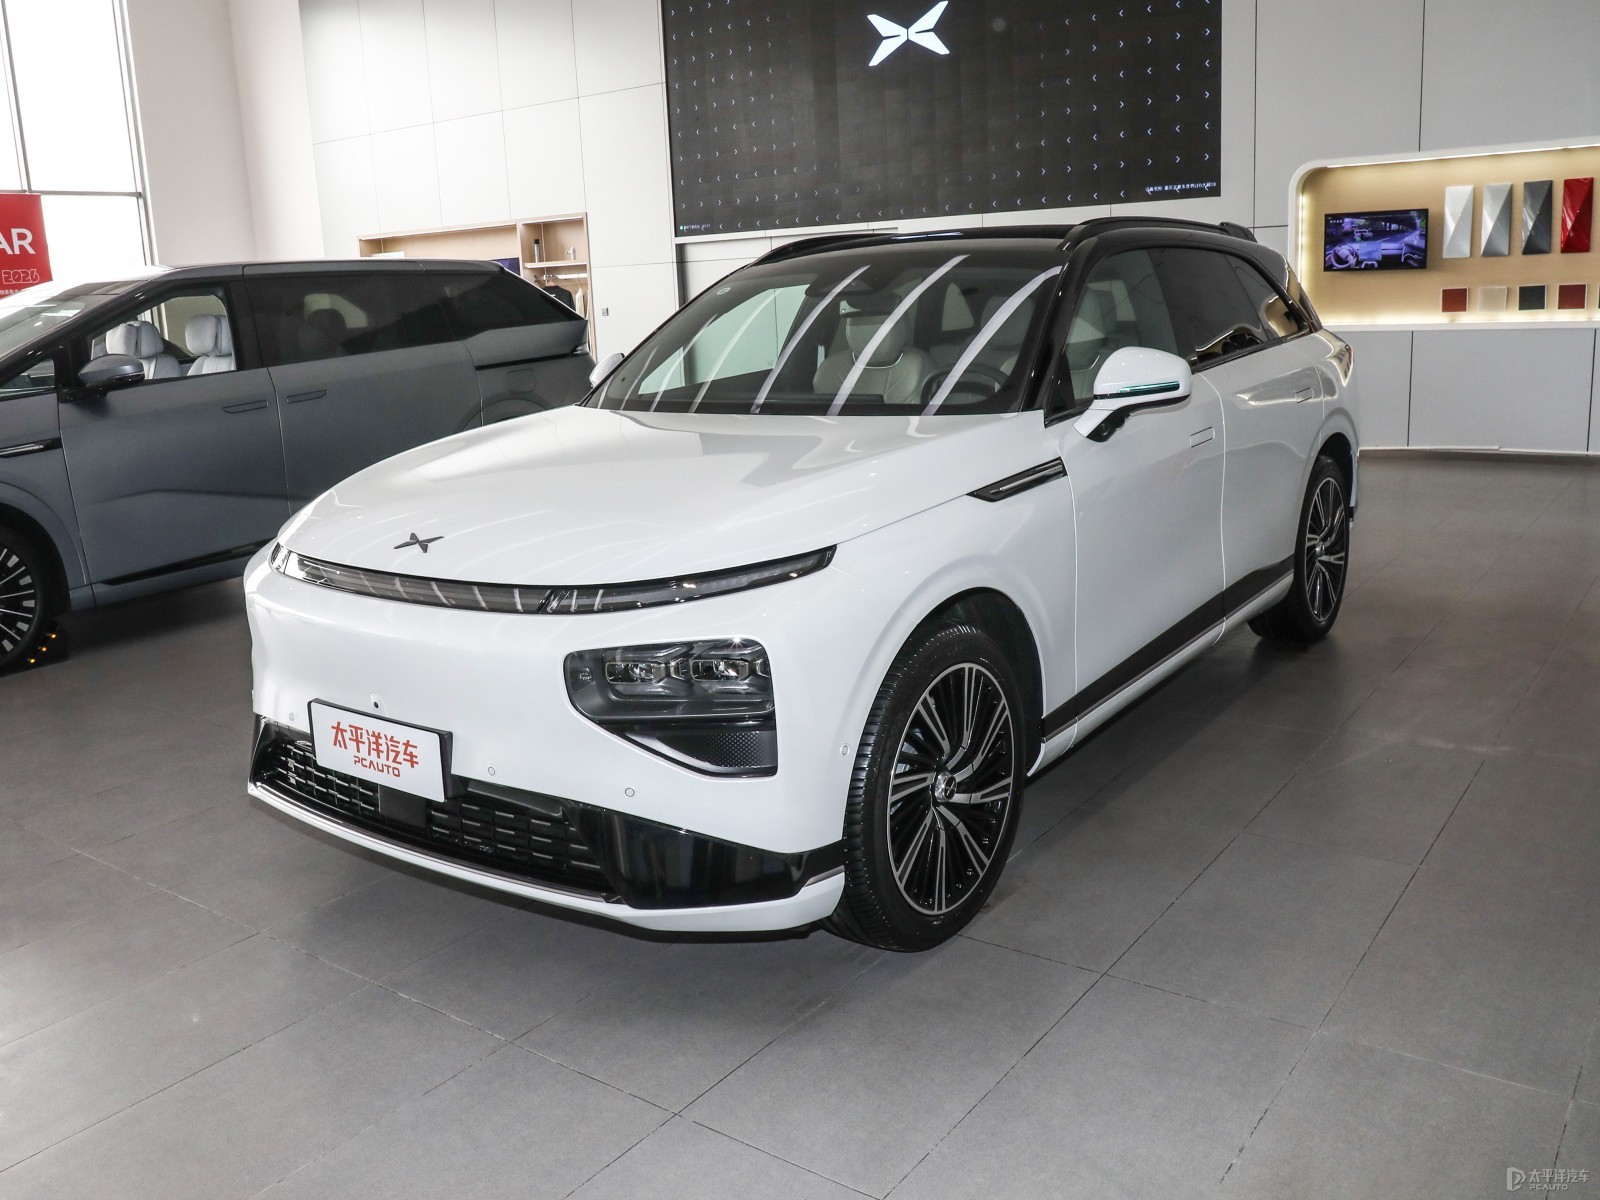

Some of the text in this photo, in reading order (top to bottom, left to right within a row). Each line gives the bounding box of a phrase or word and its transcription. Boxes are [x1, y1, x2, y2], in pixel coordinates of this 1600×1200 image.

[331, 721, 419, 768] 太平洋汽车
[353, 755, 401, 778] PCAUTO
